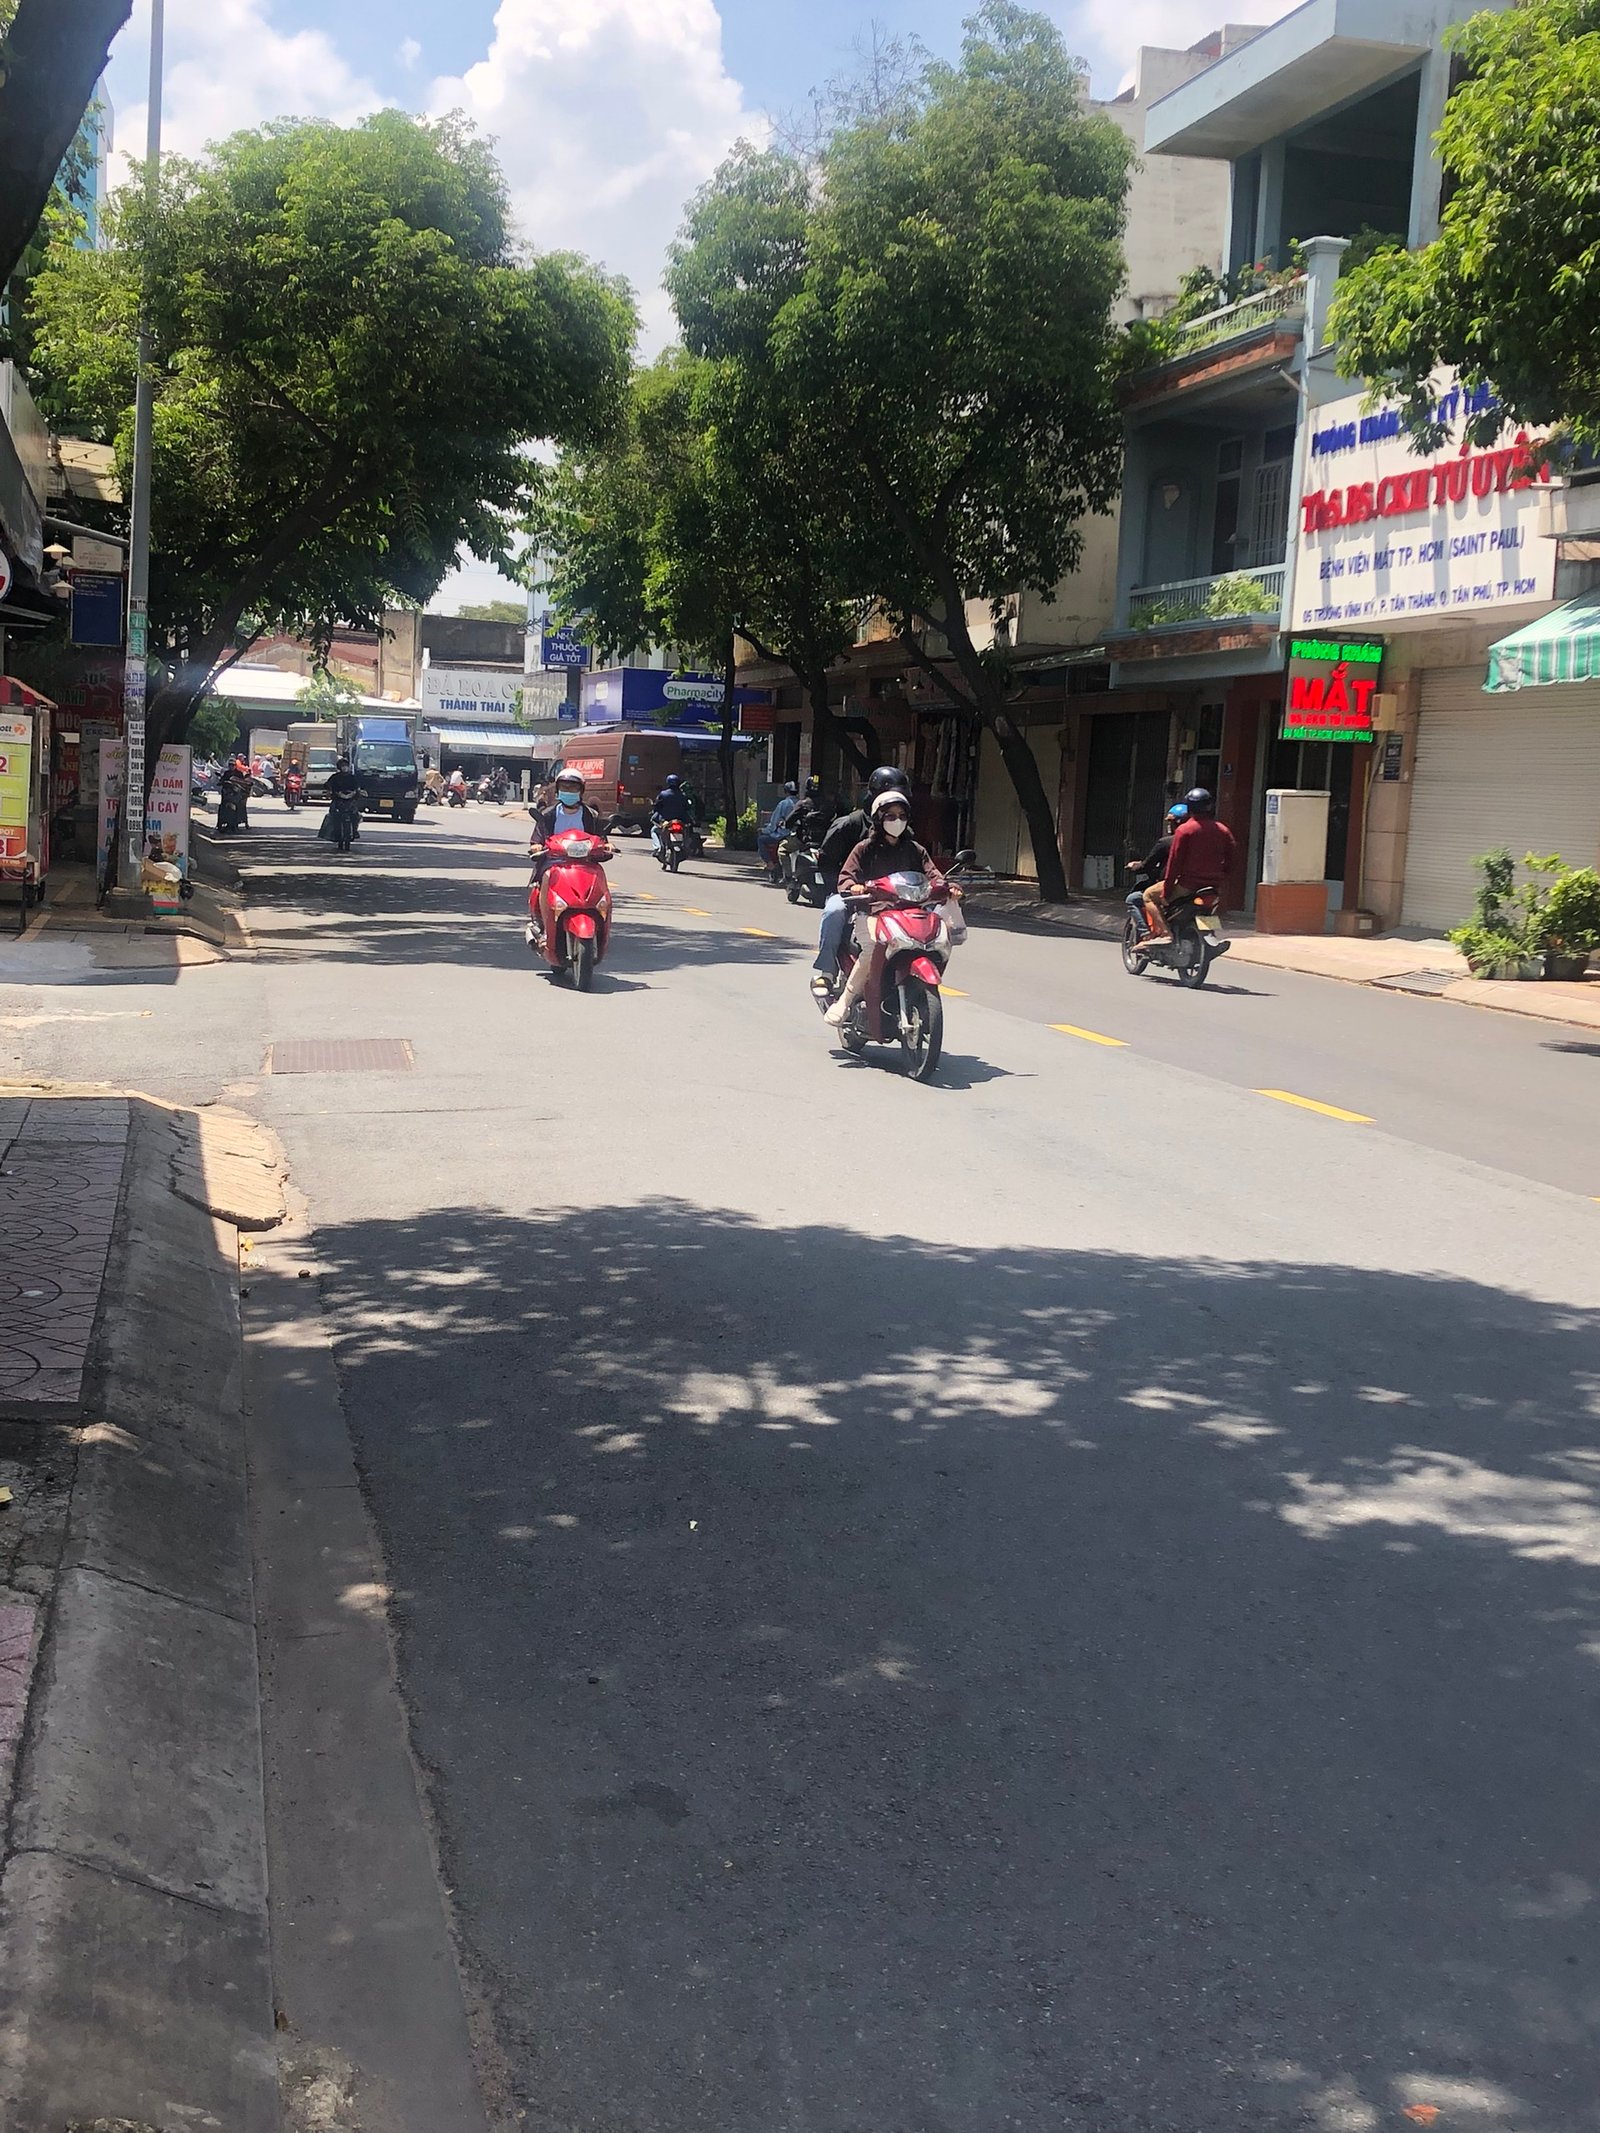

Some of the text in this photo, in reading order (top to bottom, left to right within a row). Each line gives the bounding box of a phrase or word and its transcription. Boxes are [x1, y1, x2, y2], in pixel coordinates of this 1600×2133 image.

[1398, 546, 1416, 567] TP.
[1417, 539, 1444, 564] HCM
[1446, 532, 1487, 561] (SAINT
[1488, 525, 1525, 552] PAUL)
[1496, 581, 1511, 598] TP.
[1513, 576, 1536, 596] HCM
[667, 685, 725, 701] Pharmacity
[1290, 661, 1376, 714] MẮT
[440, 698, 477, 711] THÀNH
[480, 702, 505, 713] THÁI
